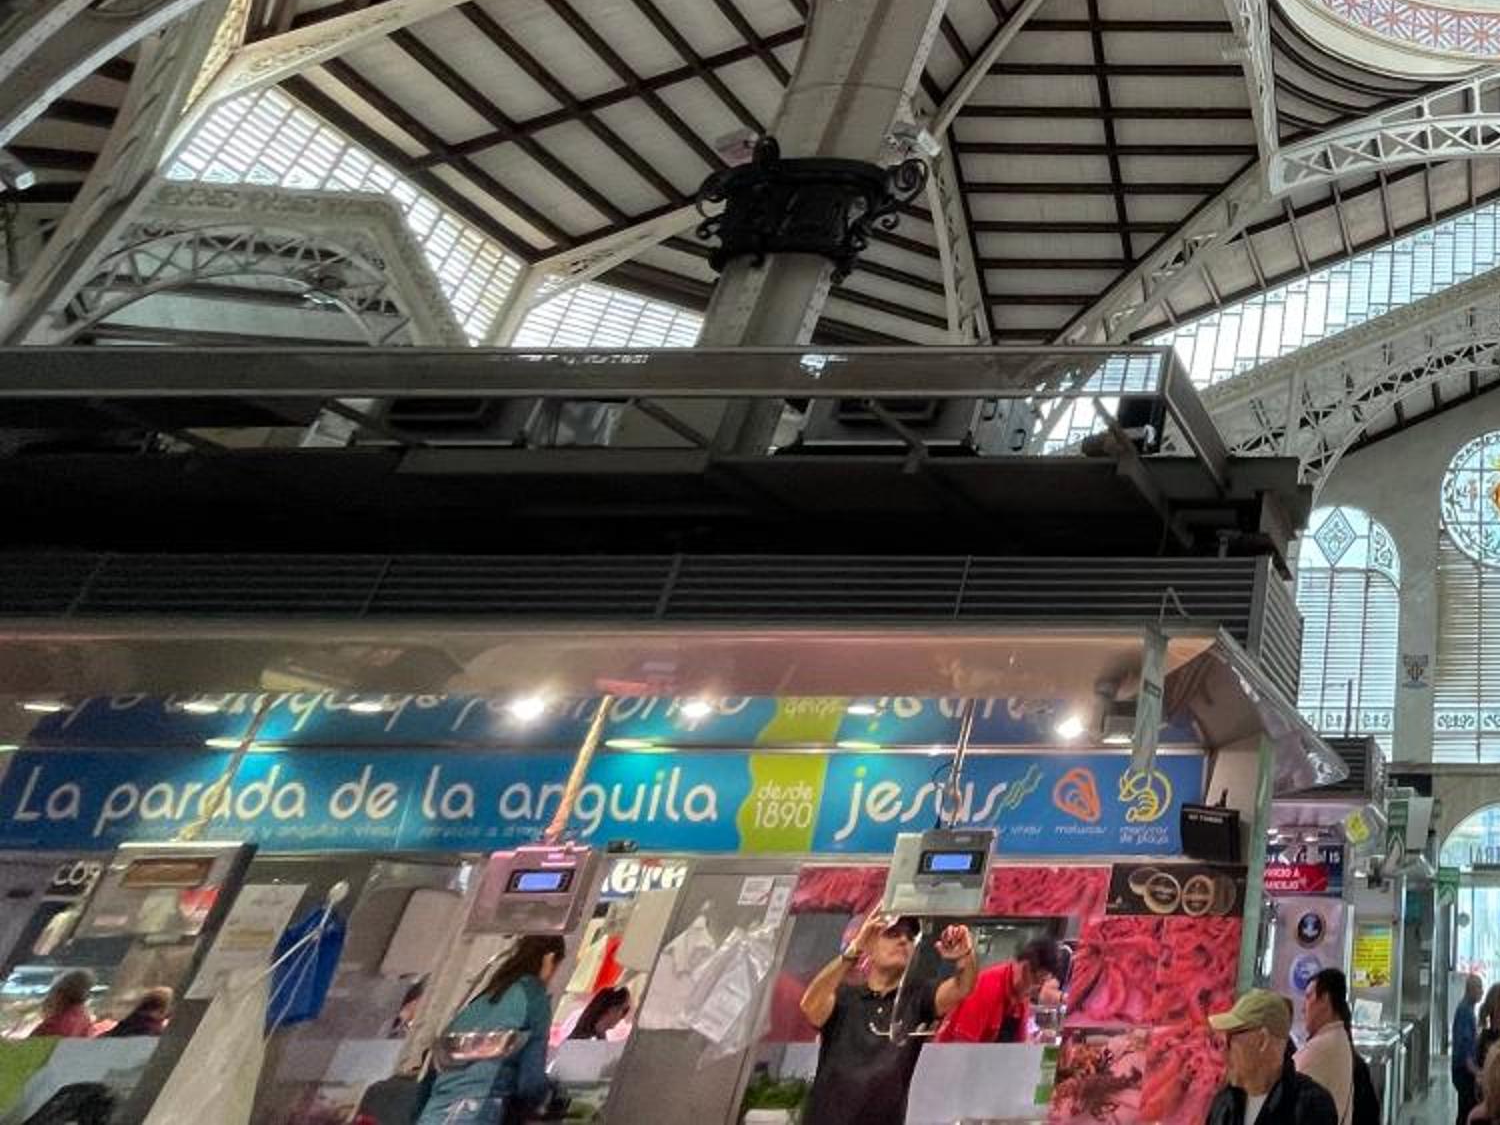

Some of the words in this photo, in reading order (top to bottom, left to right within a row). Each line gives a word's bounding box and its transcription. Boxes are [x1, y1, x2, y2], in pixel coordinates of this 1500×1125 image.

[13, 765, 80, 821] La
[93, 764, 306, 837] parada
[329, 764, 398, 820] de
[422, 764, 475, 820] la
[499, 765, 718, 837] anguila
[754, 801, 813, 828] 1890
